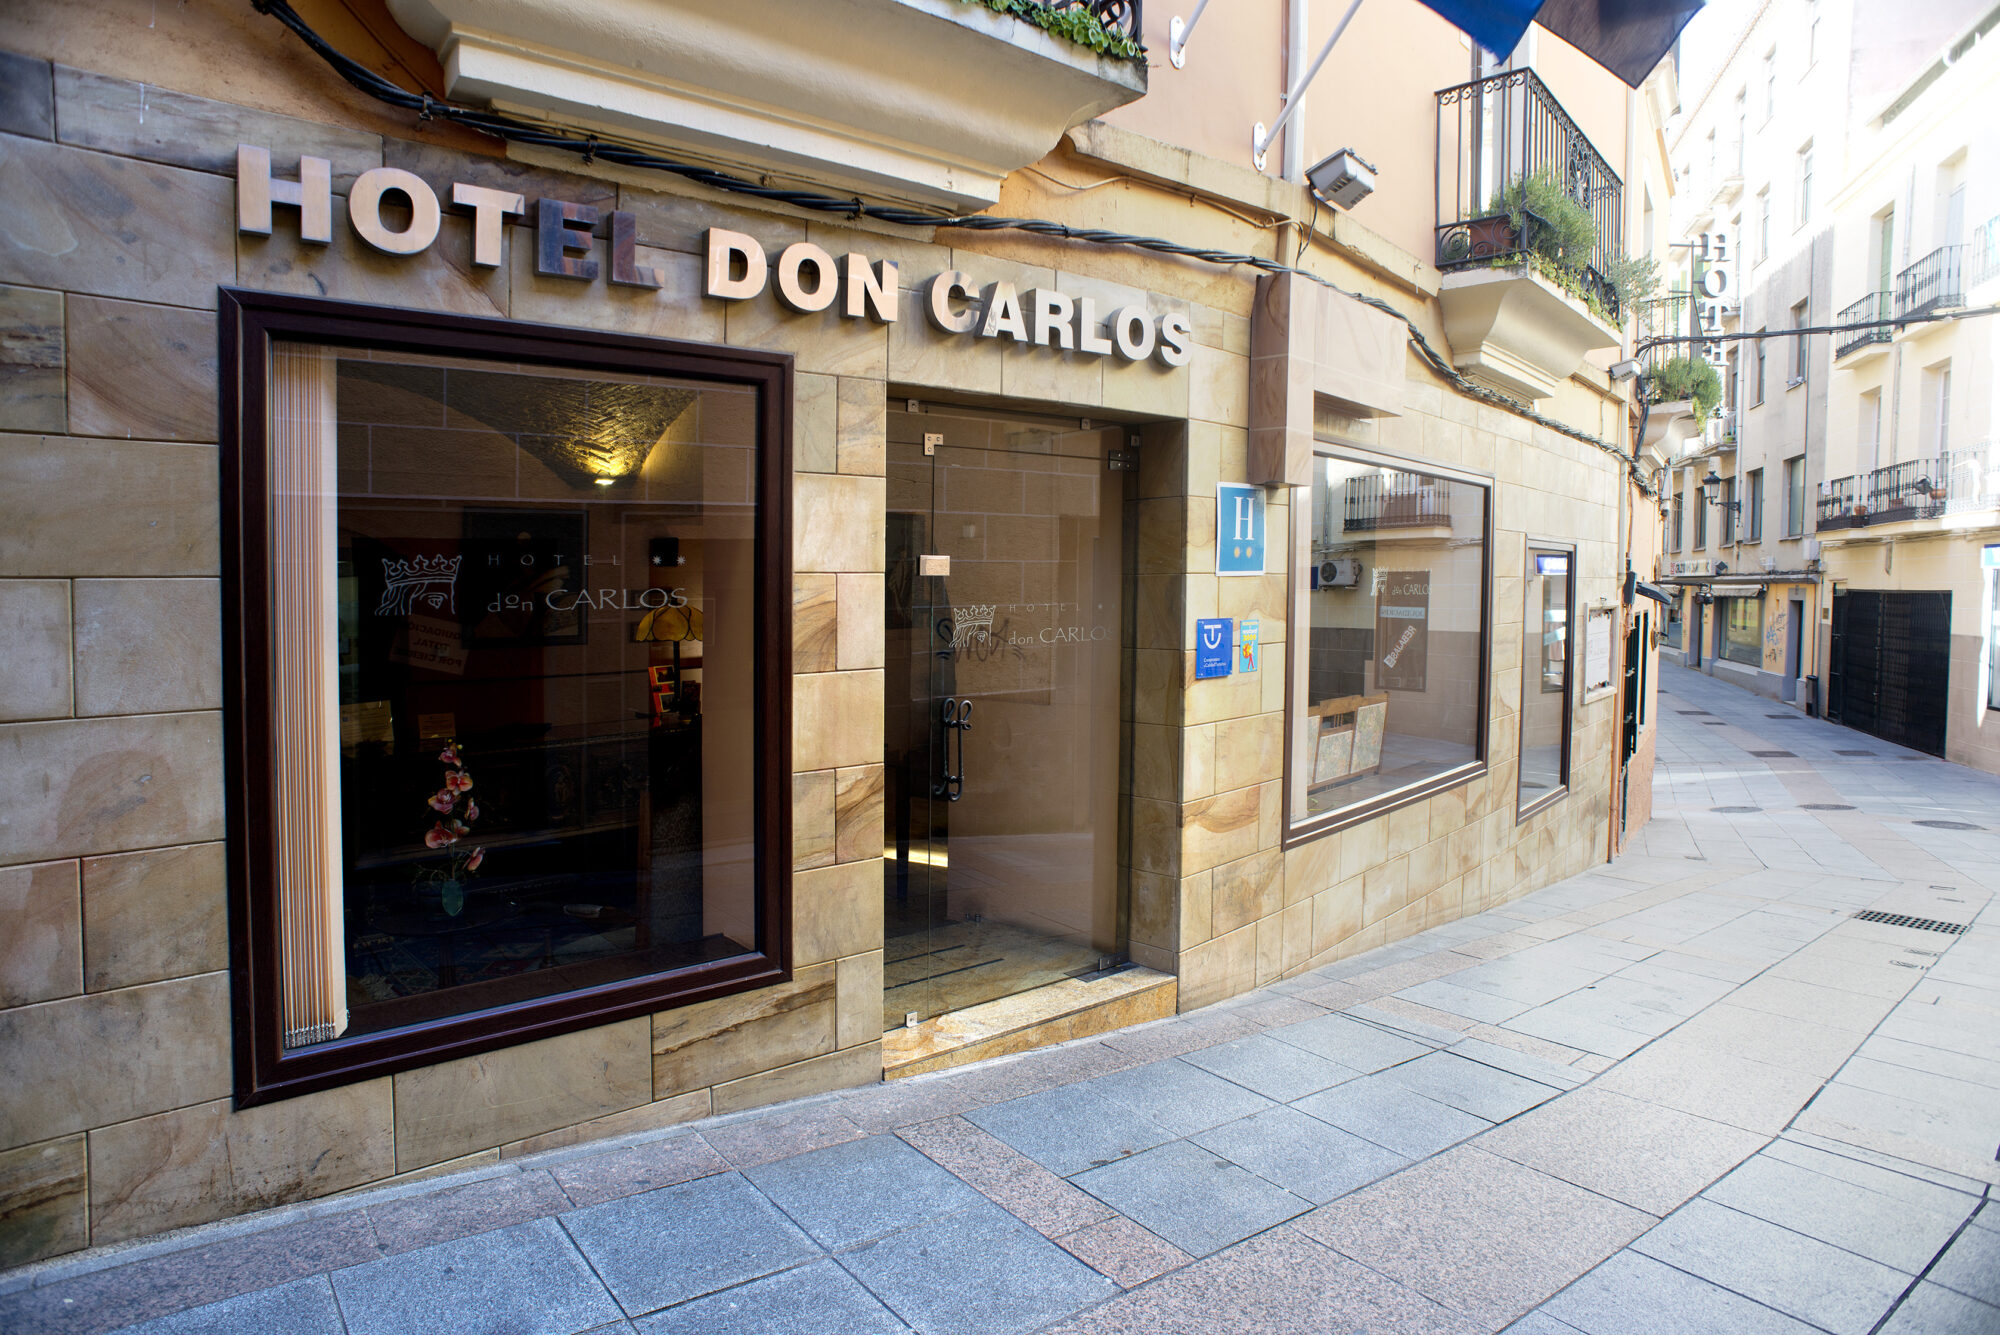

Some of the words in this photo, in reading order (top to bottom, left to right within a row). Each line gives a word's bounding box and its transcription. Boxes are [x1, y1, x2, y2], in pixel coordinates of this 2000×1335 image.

[237, 144, 664, 290] HOTEL
[702, 227, 899, 324] DON
[924, 270, 1192, 368] CARLOS
[1233, 496, 1255, 540] H
[488, 554, 622, 567] HOTEL
[545, 587, 688, 612] CARLOS
[1009, 603, 1081, 612] HOTEL
[1008, 631, 1034, 645] don
